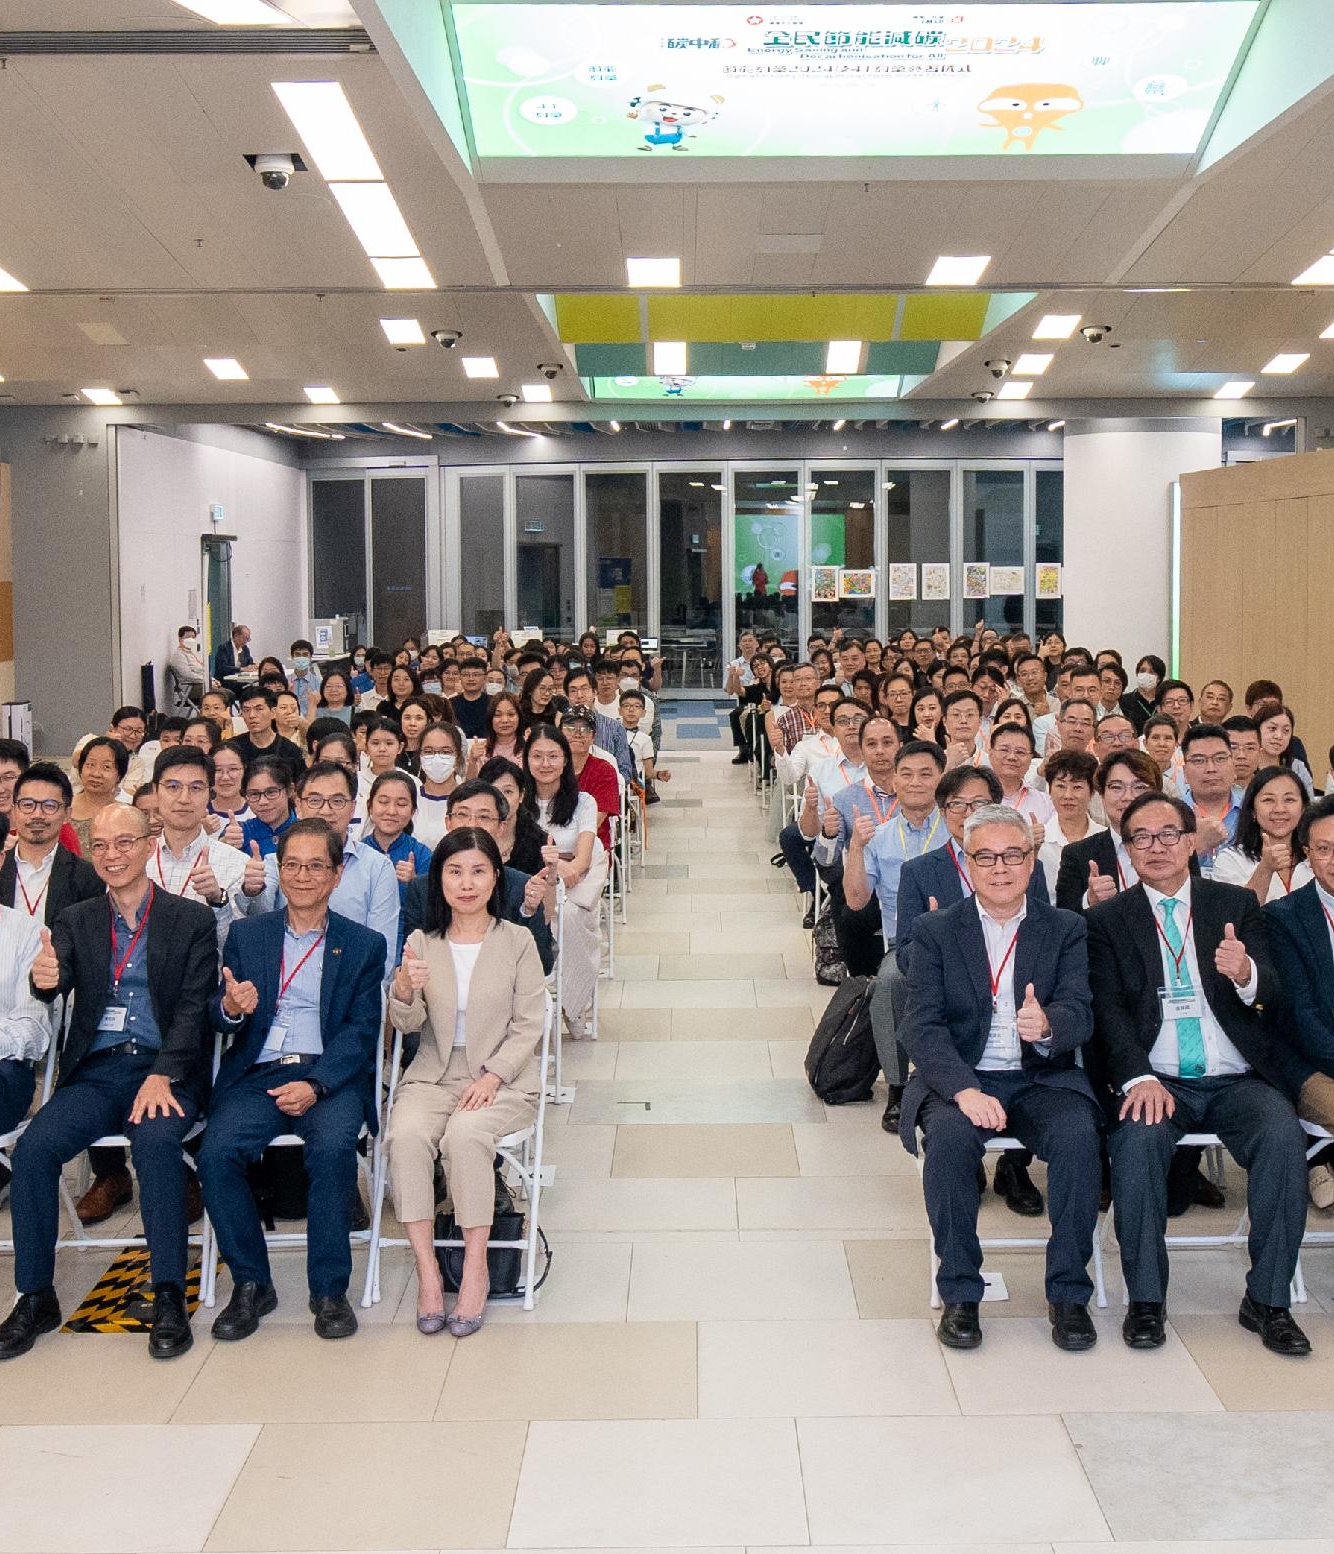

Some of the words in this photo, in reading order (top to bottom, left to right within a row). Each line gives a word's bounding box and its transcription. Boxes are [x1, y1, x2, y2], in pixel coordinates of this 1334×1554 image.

[763, 30, 946, 47] 全民節能減碳
[945, 37, 1045, 54] 2024
